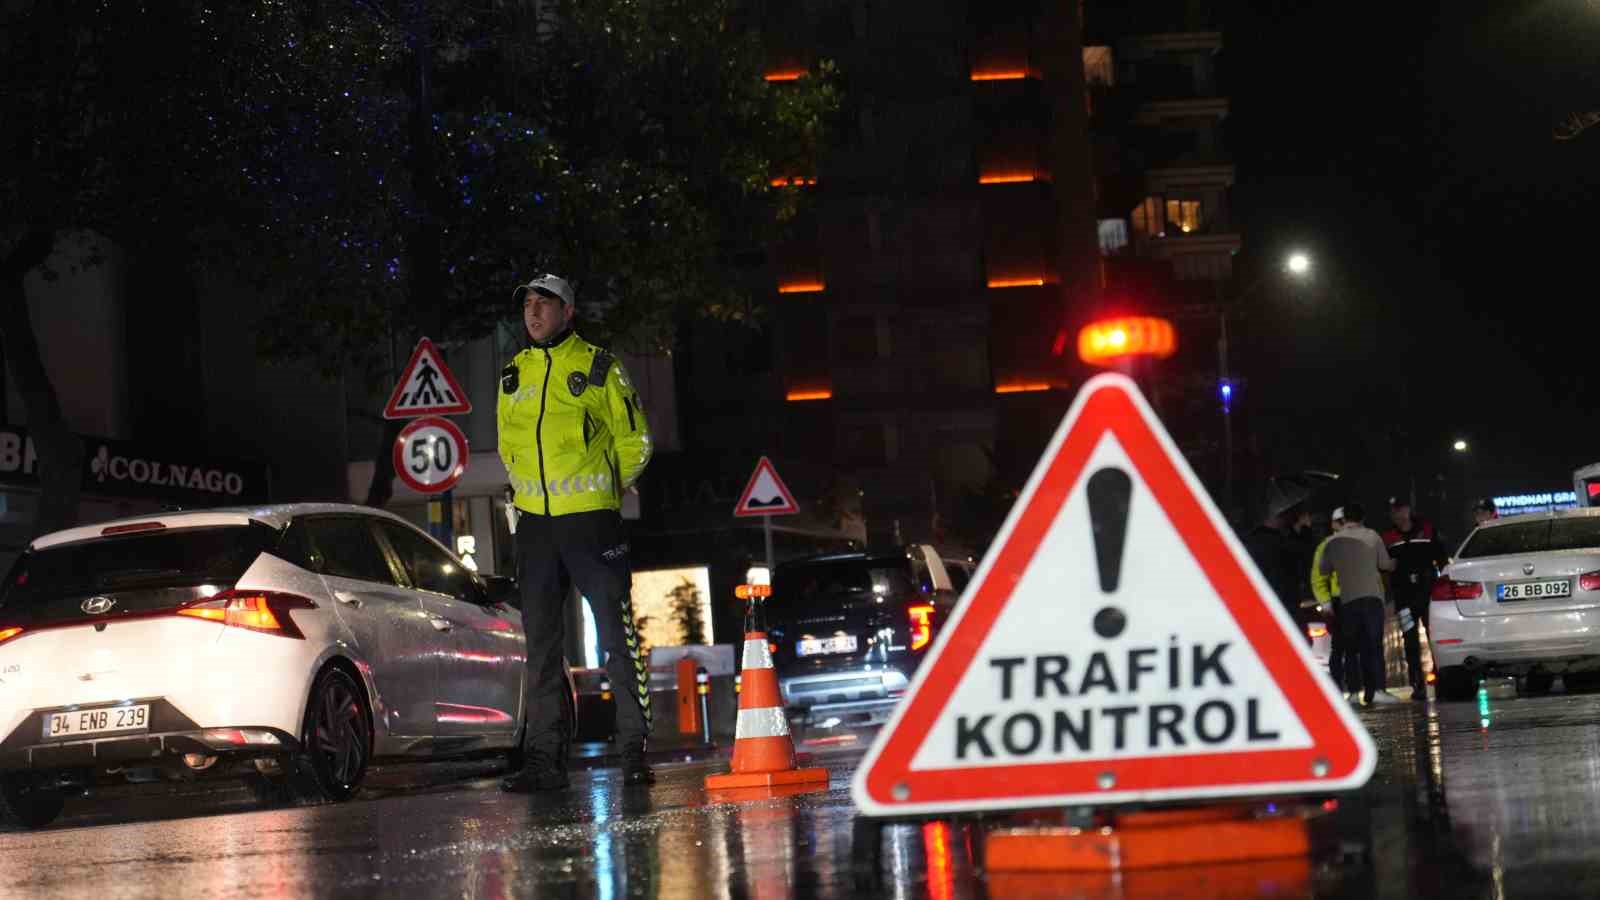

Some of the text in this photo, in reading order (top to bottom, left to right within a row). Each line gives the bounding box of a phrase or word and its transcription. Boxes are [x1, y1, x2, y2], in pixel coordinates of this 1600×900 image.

[411, 436, 452, 474] 50
[109, 456, 243, 495] COLNAGO
[1492, 493, 1552, 507] WYNDHAM
[1504, 582, 1568, 598] 26 BB 092
[990, 634, 1234, 700] TRAFİK
[52, 708, 145, 734] 34 ENB 239
[956, 698, 1280, 760] KONTROL
